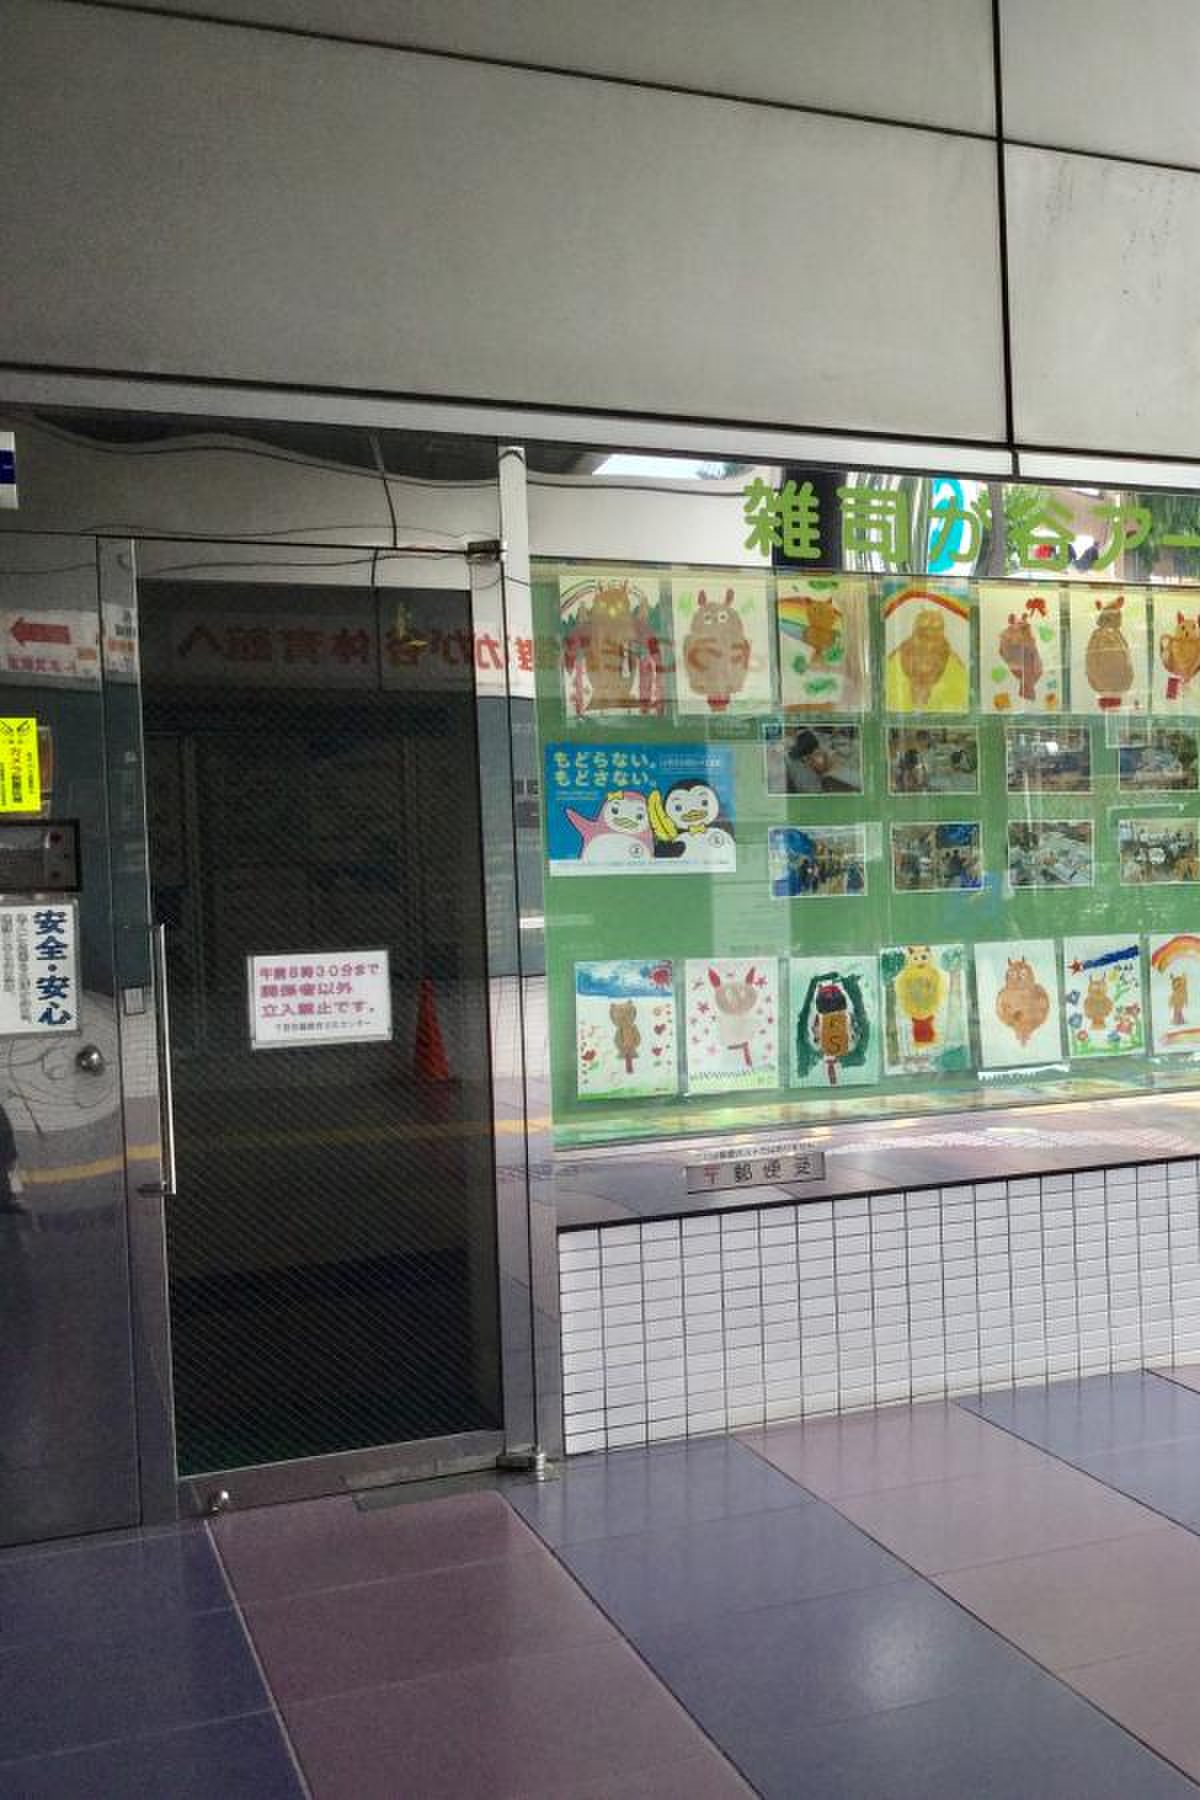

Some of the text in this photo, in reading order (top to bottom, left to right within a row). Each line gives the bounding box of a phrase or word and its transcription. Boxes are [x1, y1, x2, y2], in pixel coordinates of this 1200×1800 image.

[33, 910, 72, 1025] 安全・安心
